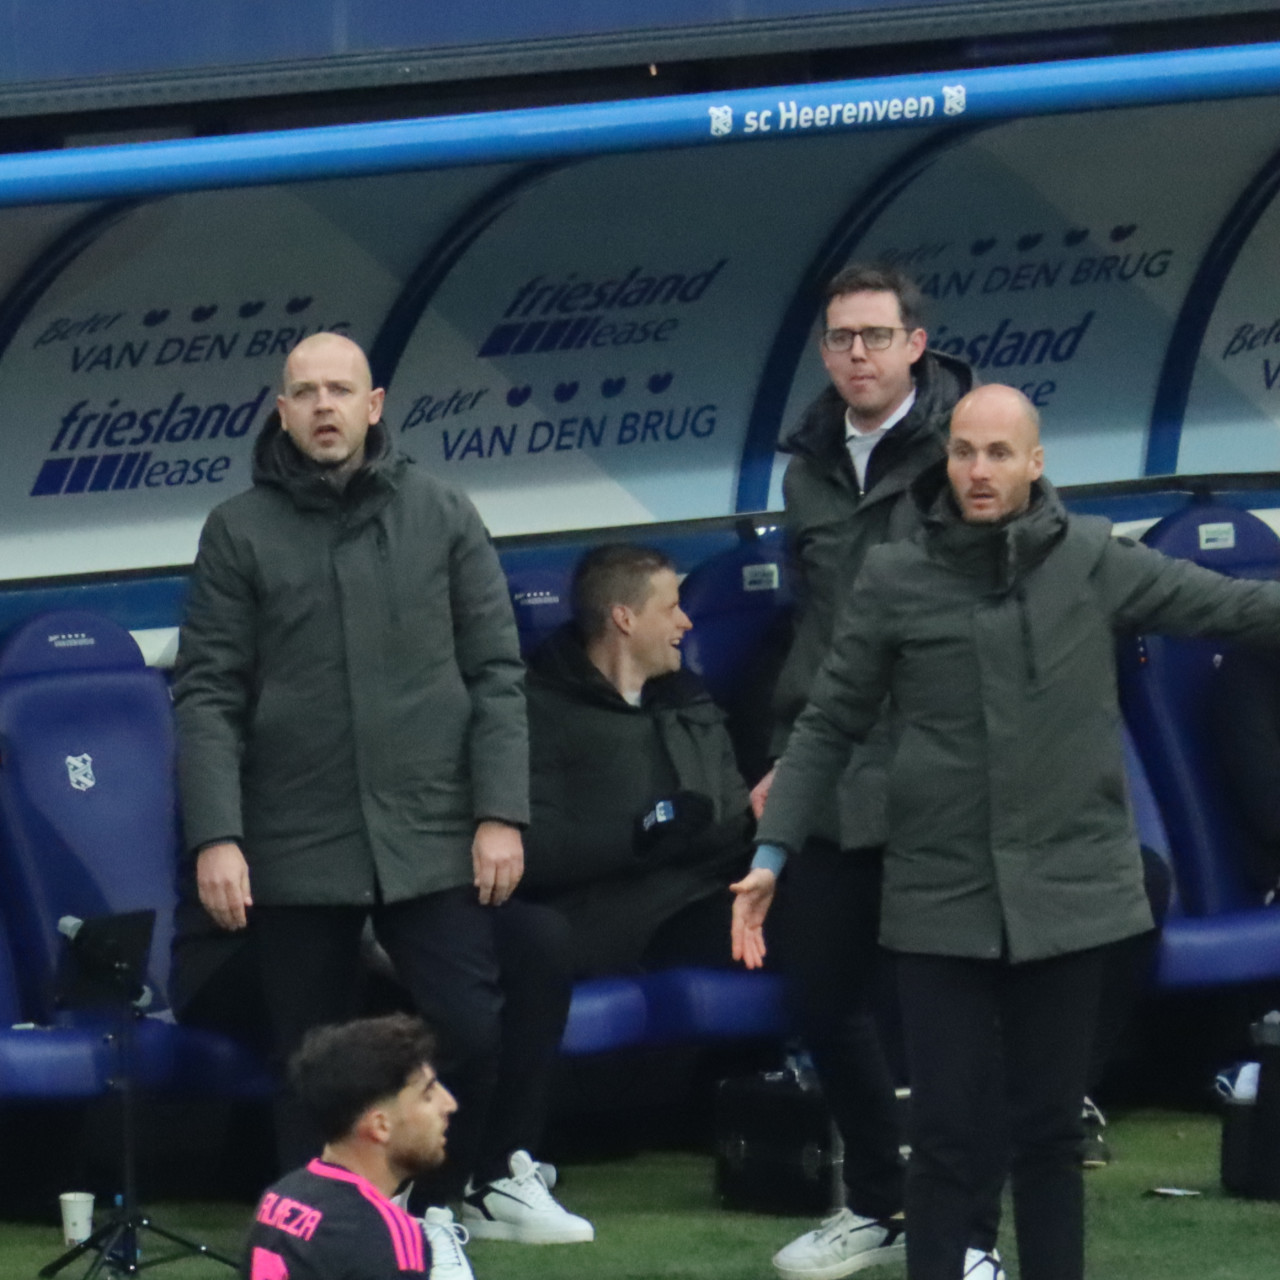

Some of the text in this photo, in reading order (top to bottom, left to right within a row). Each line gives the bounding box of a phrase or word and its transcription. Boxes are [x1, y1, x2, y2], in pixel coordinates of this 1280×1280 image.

[743, 95, 936, 133] sc Heerenveen
[502, 257, 730, 319] friesland
[916, 249, 1175, 299] AN DEN BRUG
[69, 340, 148, 374] VAN
[153, 332, 239, 367] DEN
[50, 385, 271, 452] friesland
[399, 387, 490, 434] Beter
[441, 403, 718, 462] VAN DEN BRUG
